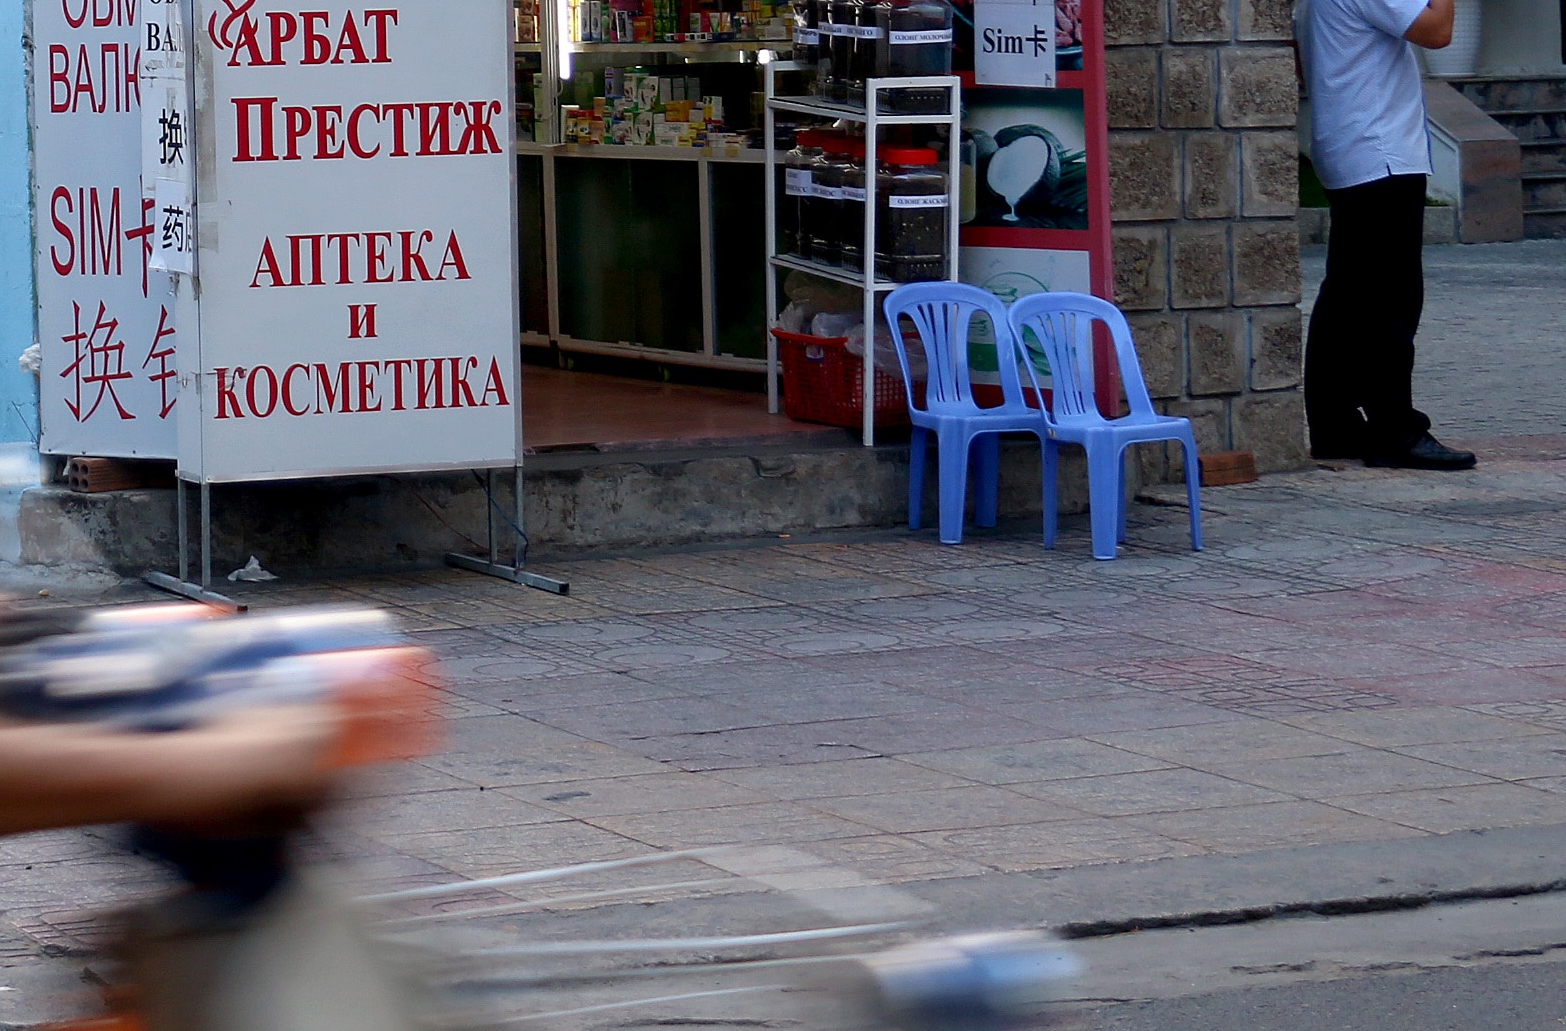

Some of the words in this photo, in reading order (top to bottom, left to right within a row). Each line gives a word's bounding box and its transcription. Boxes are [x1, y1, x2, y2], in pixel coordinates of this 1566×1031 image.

[227, 9, 399, 67] АРБАТ
[983, 24, 1048, 58] Sim卡
[231, 97, 503, 162] ПРЕСТИЖ
[248, 228, 472, 289] АПТЕКА
[213, 354, 510, 419] КОСМЕТИКА
